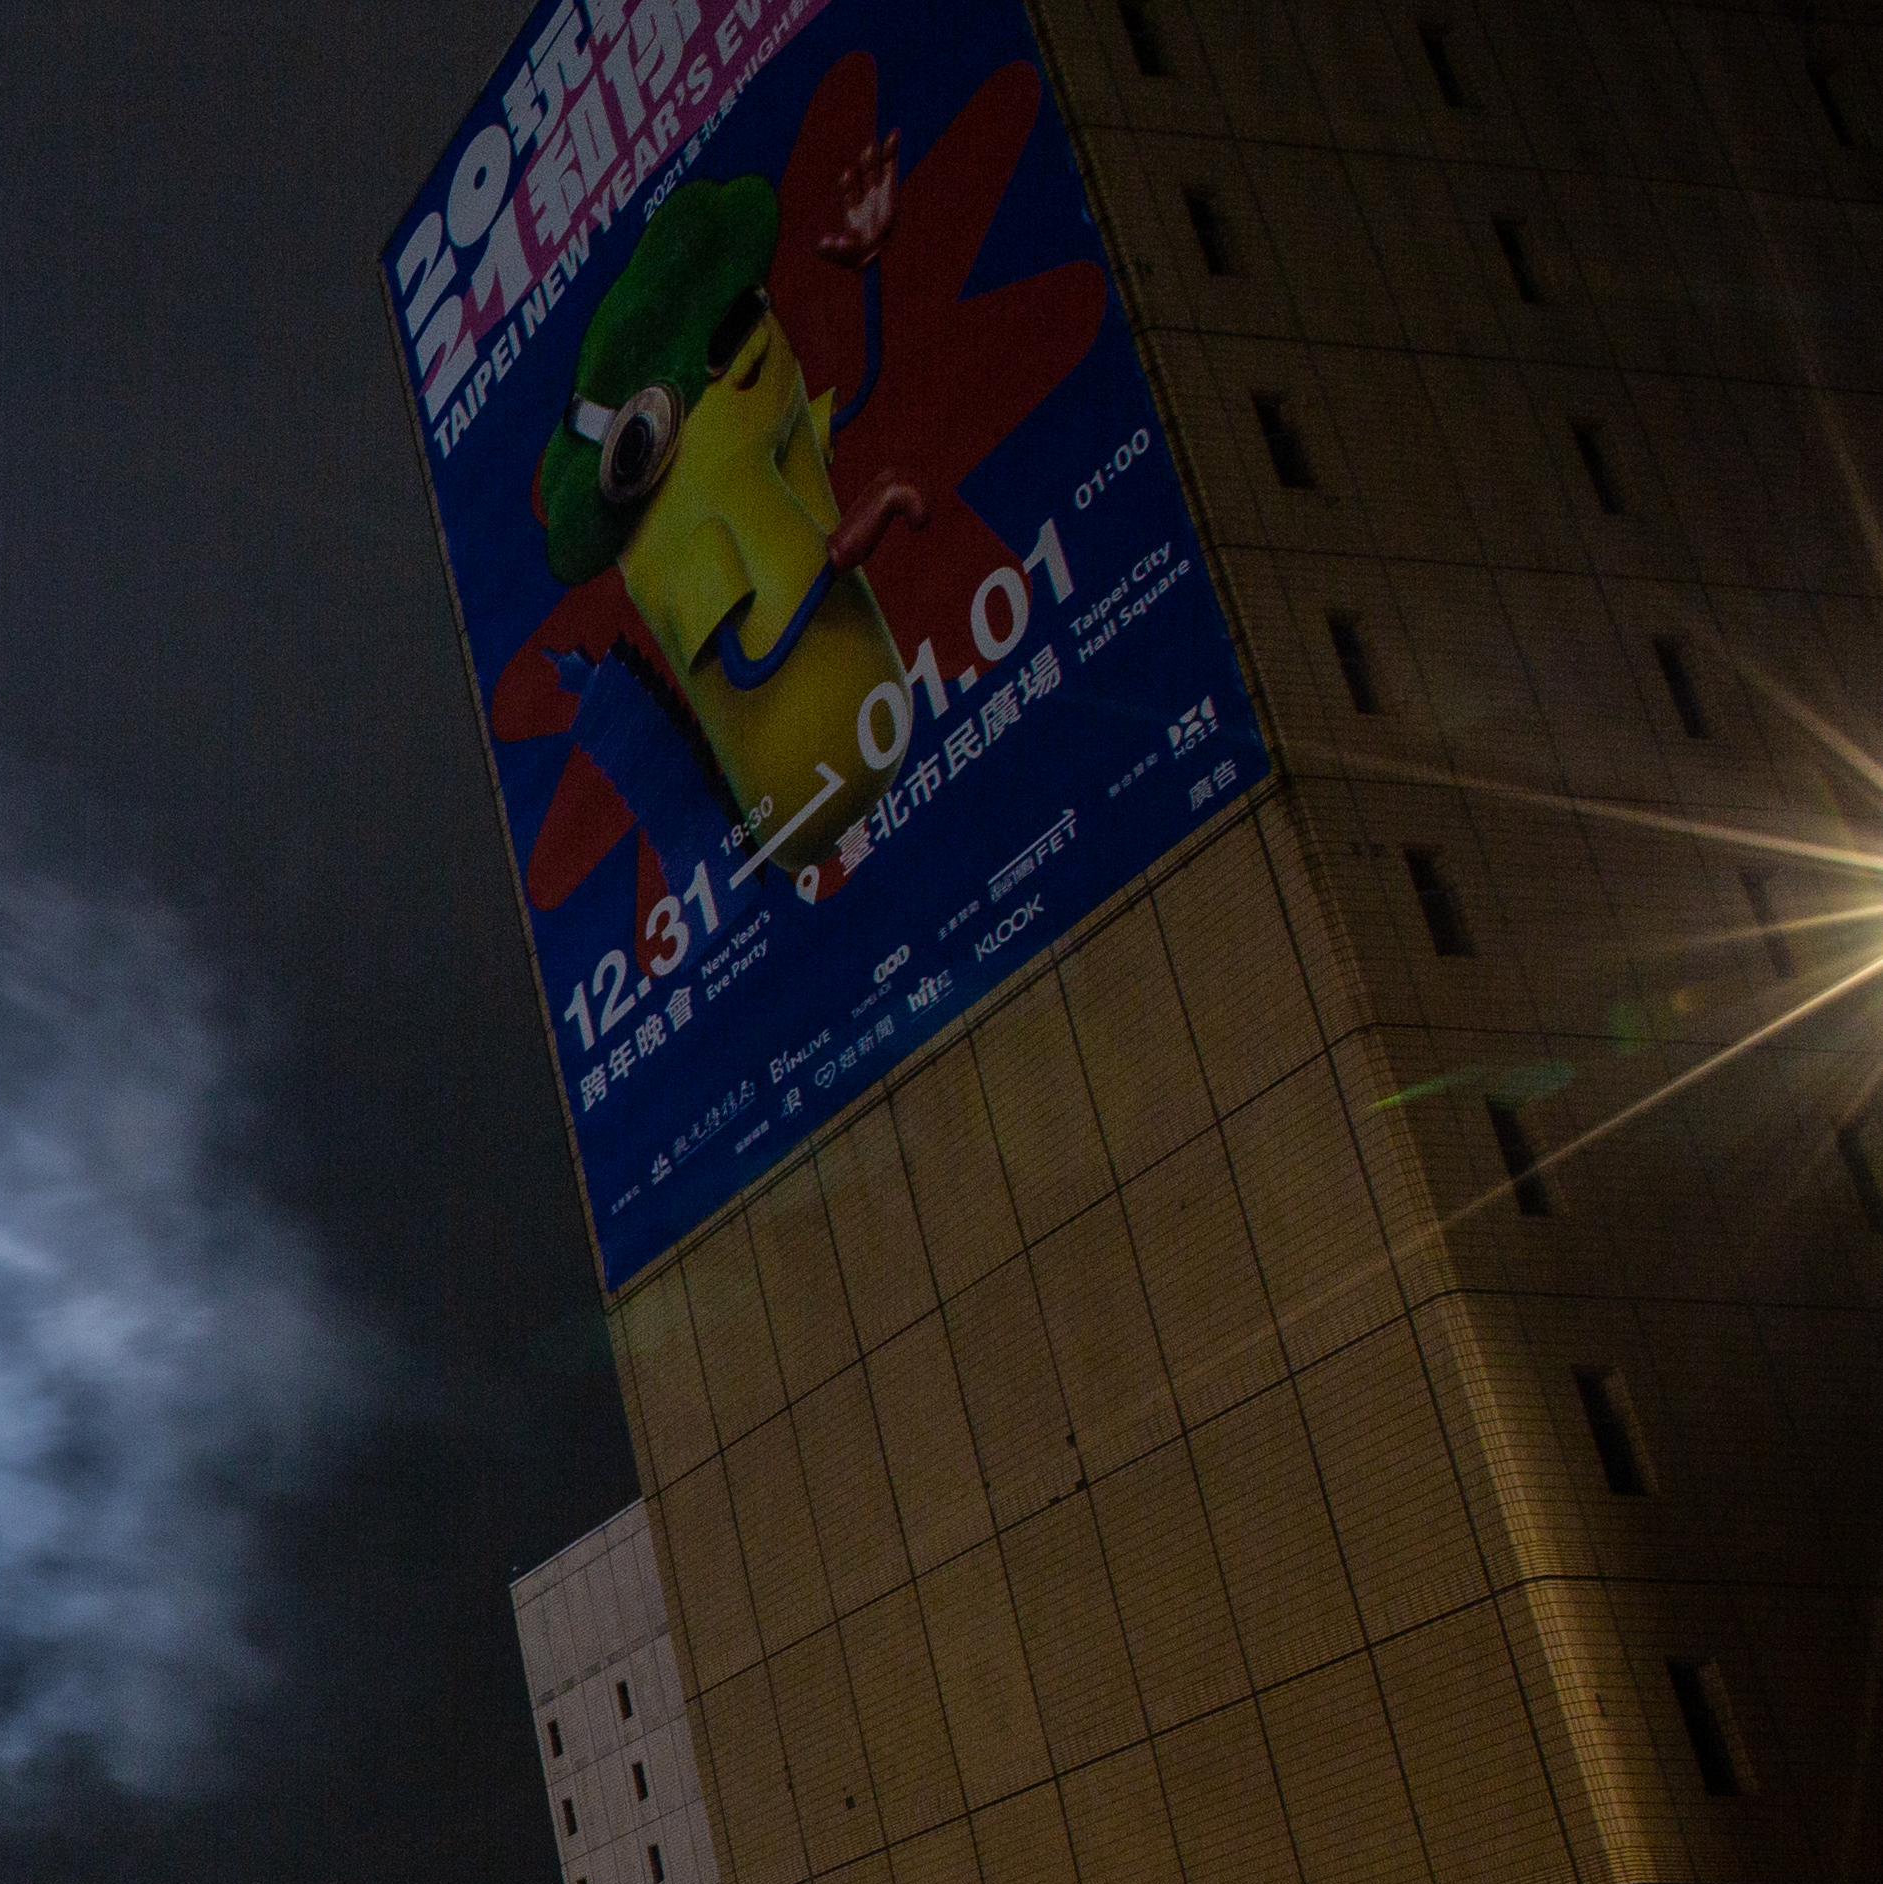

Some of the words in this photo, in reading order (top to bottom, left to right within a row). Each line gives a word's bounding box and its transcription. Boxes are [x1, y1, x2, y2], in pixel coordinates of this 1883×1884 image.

[432, 331, 523, 459] TAIPEI
[520, 219, 591, 340] NEW
[589, 52, 714, 234] YEAR'S
[1074, 427, 1152, 510] 01:00
[1069, 576, 1130, 637] Taipei
[1132, 540, 1173, 584] City
[1077, 620, 1119, 664] Hall
[1118, 557, 1192, 628] Square
[855, 516, 1075, 772] 01.01
[834, 643, 1063, 878] 臺北市民廣場
[1189, 758, 1238, 812] 廣告
[719, 794, 775, 857] 18:30
[563, 859, 721, 1052] 12.31
[700, 944, 732, 980] New
[730, 909, 772, 957] Year's
[705, 972, 733, 1002] Eve
[731, 936, 770, 982] Party
[974, 891, 1046, 963] KLOOK
[579, 985, 693, 1113] 跨年晚會
